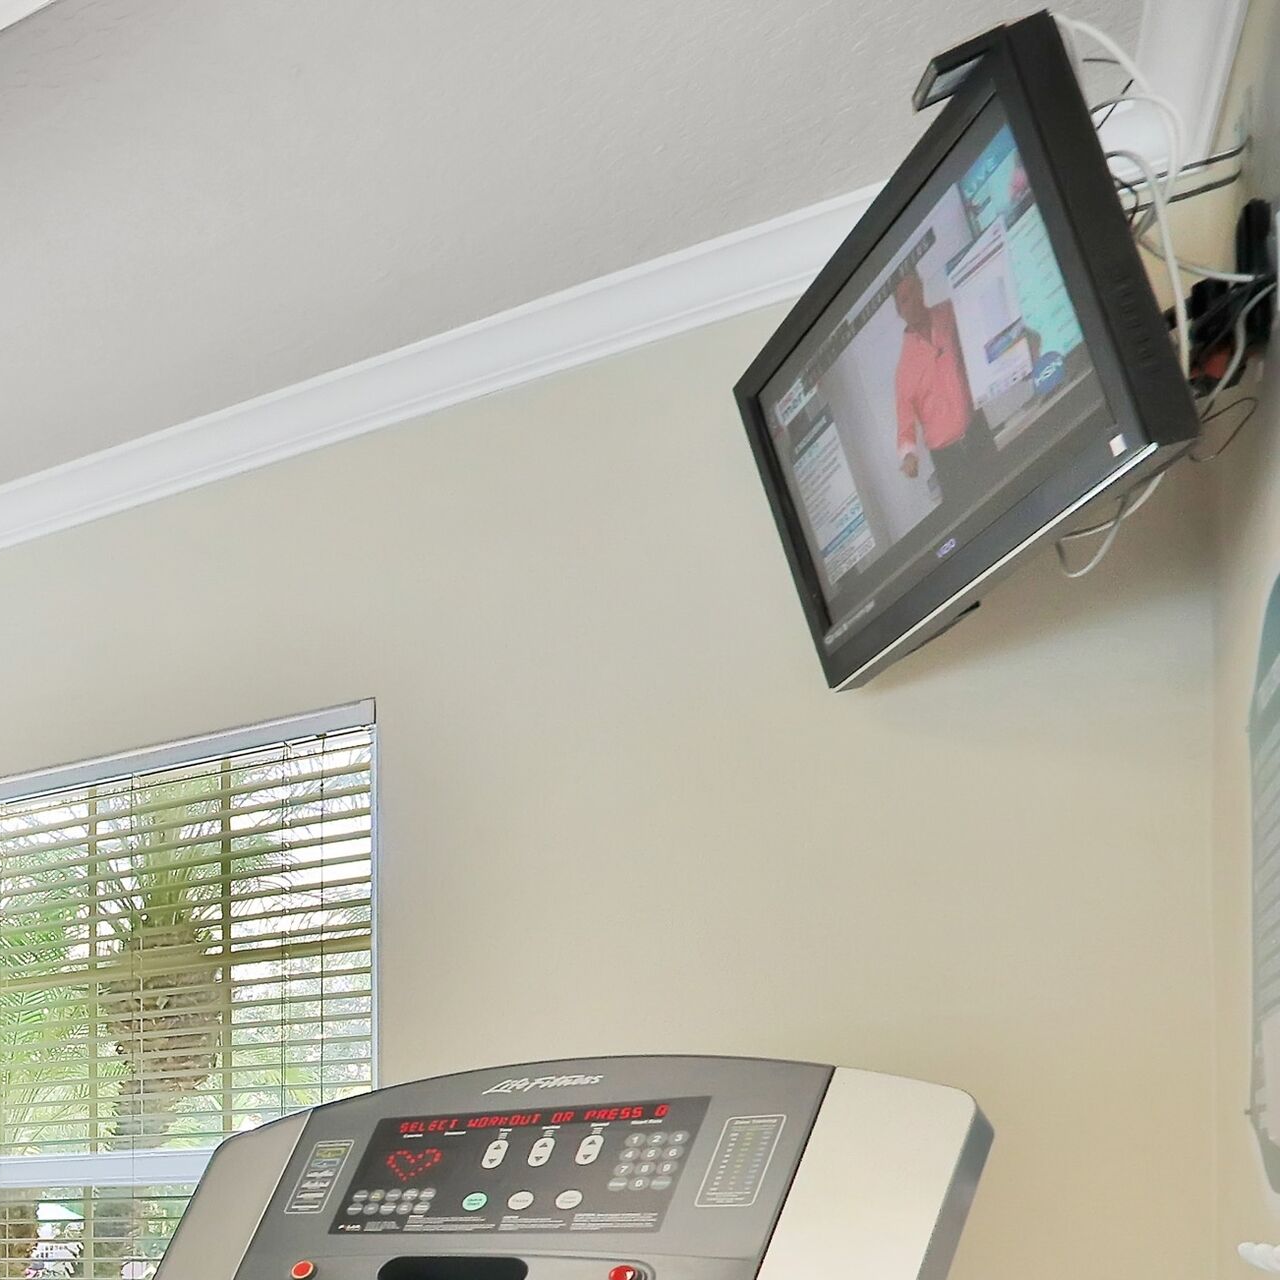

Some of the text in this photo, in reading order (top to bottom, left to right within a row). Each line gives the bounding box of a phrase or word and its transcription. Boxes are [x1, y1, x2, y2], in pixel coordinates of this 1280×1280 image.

[551, 1110, 576, 1125] OR
[583, 1106, 645, 1121] PRESS
[632, 1136, 639, 1145] 1
[651, 1135, 661, 1144] 2
[674, 1134, 684, 1142] 3
[624, 1151, 634, 1159] 4
[647, 1149, 656, 1158] 5
[669, 1148, 677, 1157] 6
[620, 1165, 629, 1174] 7
[641, 1164, 649, 1173] 8
[662, 1163, 671, 1172] 9
[635, 1179, 643, 1188] 0
